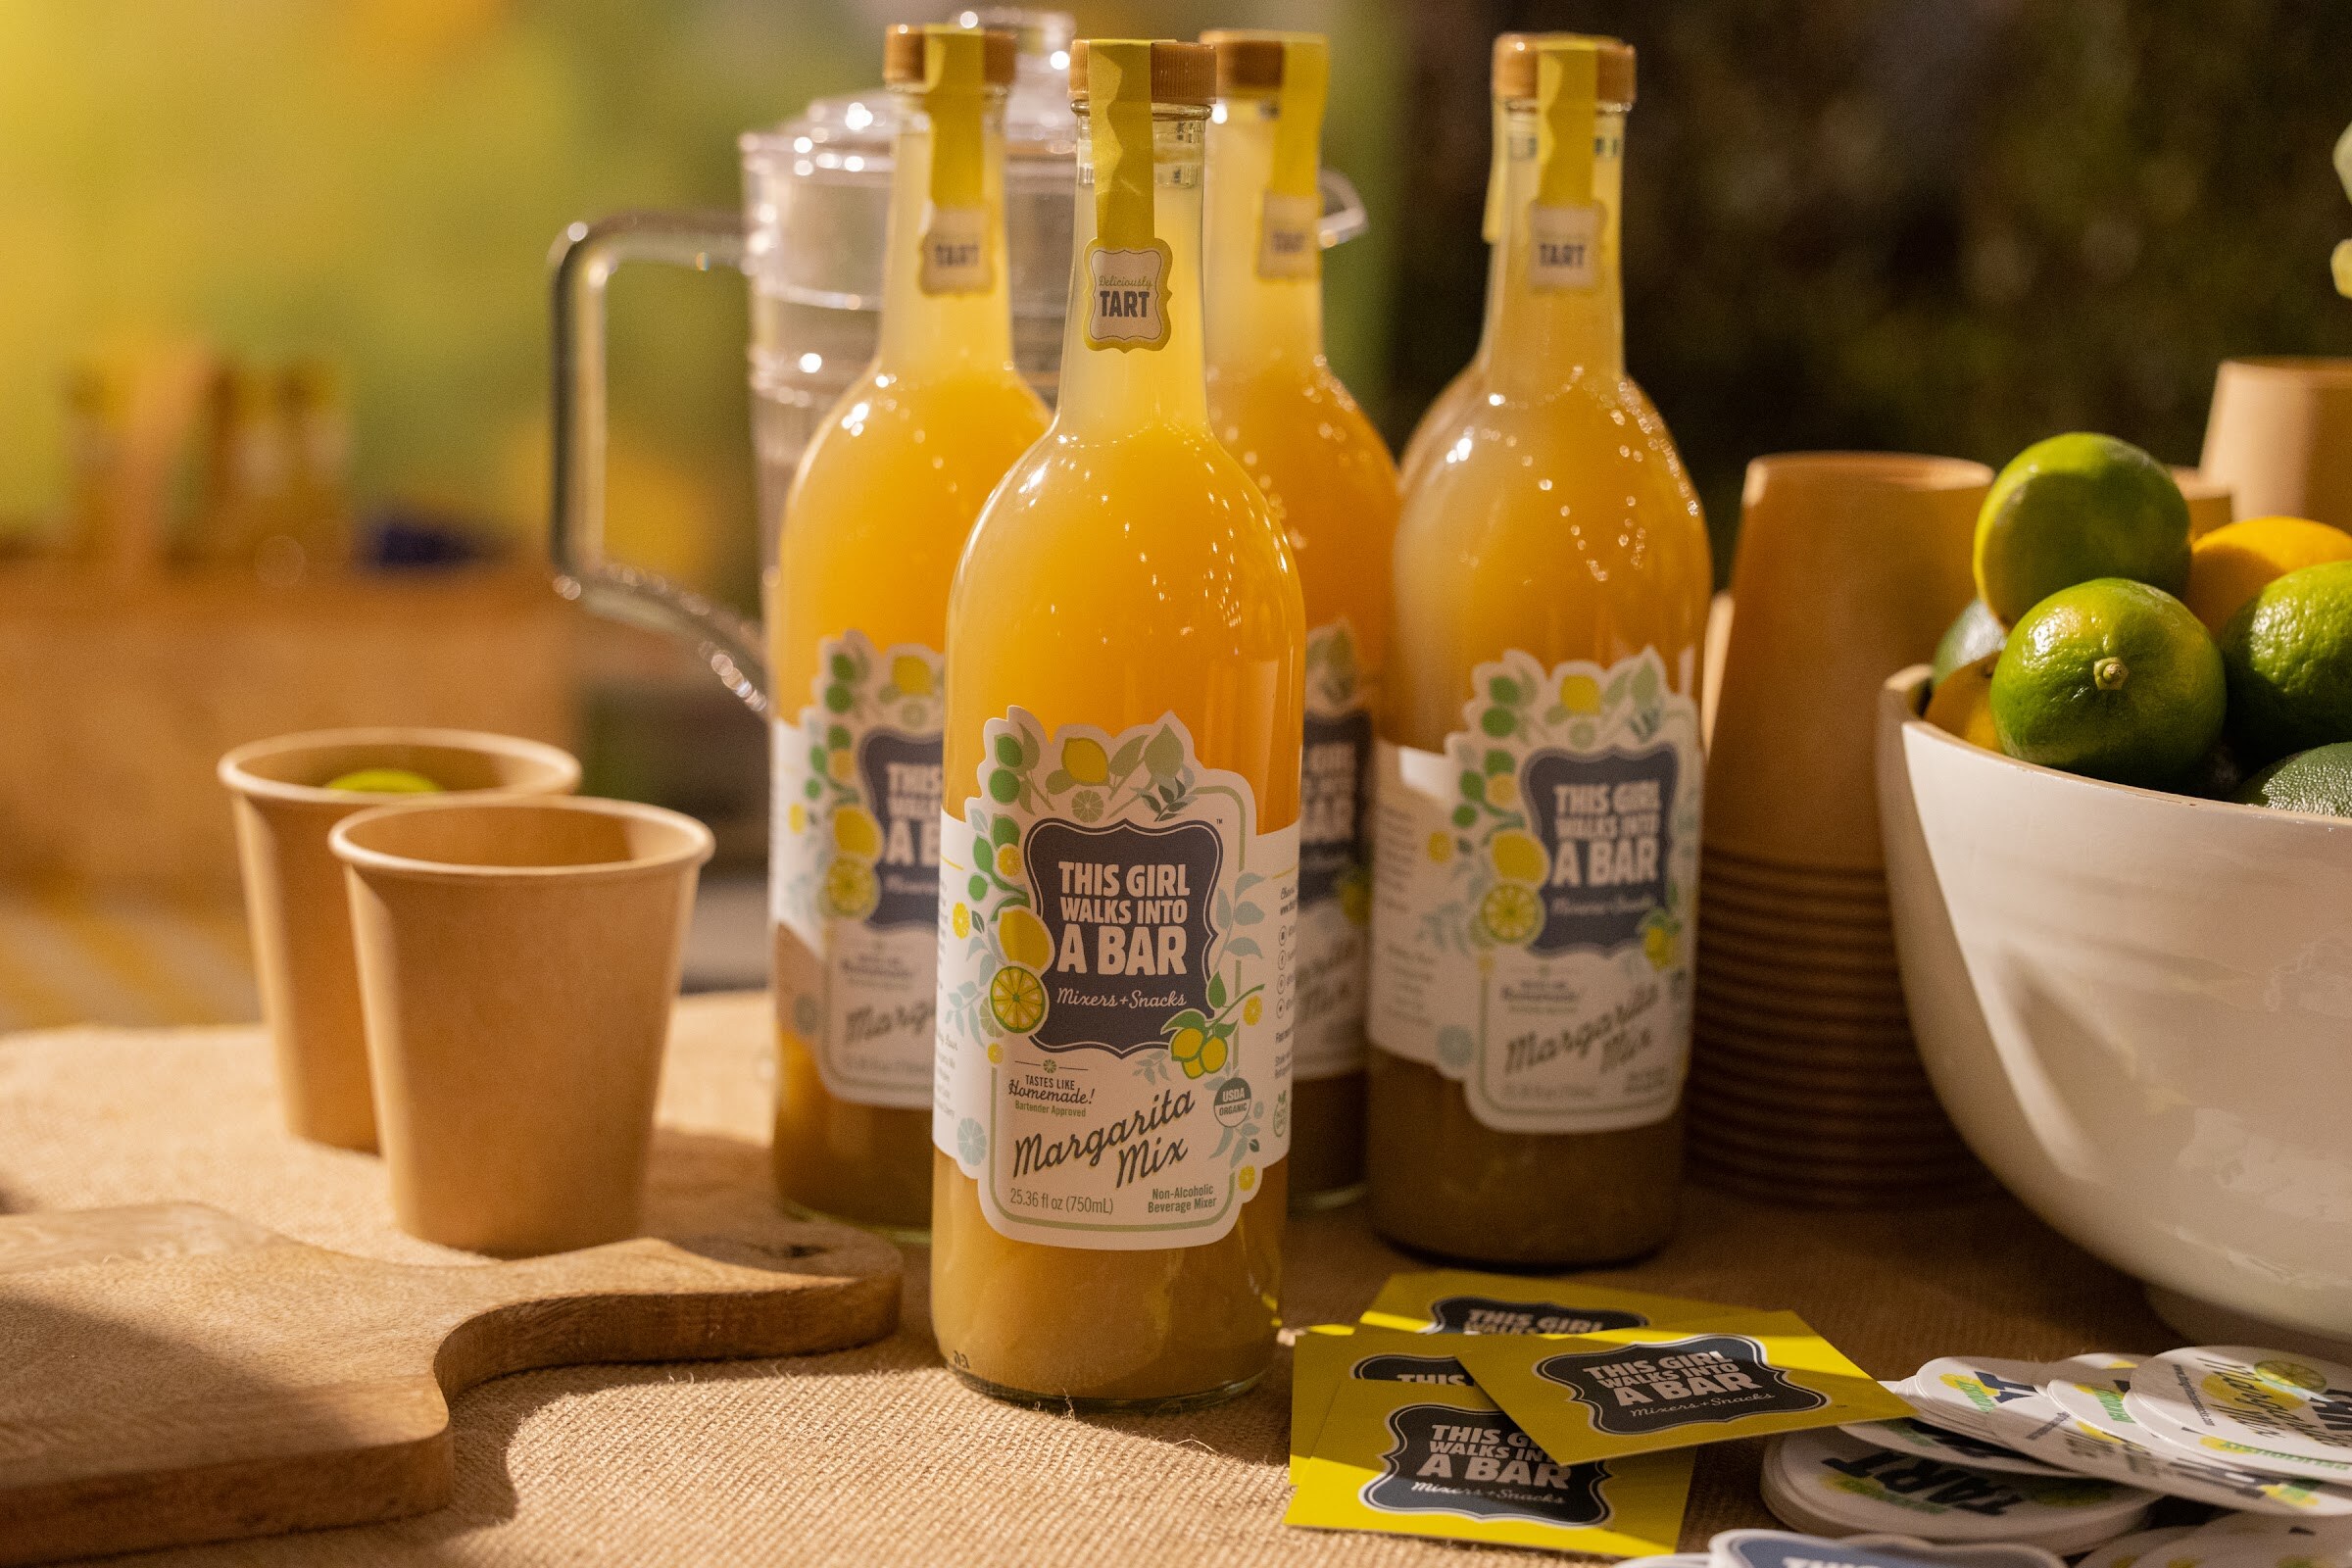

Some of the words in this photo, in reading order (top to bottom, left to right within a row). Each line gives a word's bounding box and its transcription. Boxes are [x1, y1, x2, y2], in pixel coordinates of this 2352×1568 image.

[1099, 275, 1153, 290] Deliciously
[1100, 291, 1150, 318] TART
[1588, 836, 1660, 886] BAR
[1058, 861, 1120, 897] THIS
[1126, 863, 1191, 898] GIRL
[1060, 897, 1132, 924] WALKS
[1137, 899, 1188, 924] INTO
[1056, 923, 1088, 974] A
[1098, 925, 1188, 976] BAR
[1056, 987, 1118, 1007] Mixers
[1129, 989, 1188, 1009] Snacks
[1008, 1079, 1096, 1105] Homemade!
[1025, 1074, 1054, 1090] TASTES
[1056, 1079, 1075, 1091] LIKE
[1222, 1087, 1246, 1102] USDA
[1015, 1100, 1050, 1114] Bartender
[1051, 1105, 1087, 1117] Approved
[1219, 1102, 1248, 1116] ORGANIC
[1013, 1089, 1196, 1178] Margarita
[1116, 1137, 1189, 1189] Mix
[1010, 1188, 1039, 1207] 25.36
[1051, 1198, 1063, 1210] oz
[1065, 1196, 1114, 1215] (750mL)
[1148, 1199, 1192, 1213] Beverage
[1194, 1197, 1217, 1210] Mixer
[1152, 1184, 1214, 1200] Non-Alcoholic
[1582, 1359, 1656, 1379] THIS
[1658, 1350, 1734, 1369] GIRL
[1597, 1371, 1675, 1389] WALKS
[1677, 1362, 1740, 1381] INTO
[1613, 1386, 1654, 1406] A
[1651, 1372, 1763, 1400] BAR
[1631, 1402, 1698, 1417] Mixers
[1710, 1393, 1776, 1406] Snacks
[1431, 1424, 1501, 1446] THIS
[1429, 1441, 1510, 1459] WALKS
[1515, 1447, 1556, 1463] IN
[1416, 1453, 1453, 1478] A
[1464, 1456, 1572, 1490] BAR
